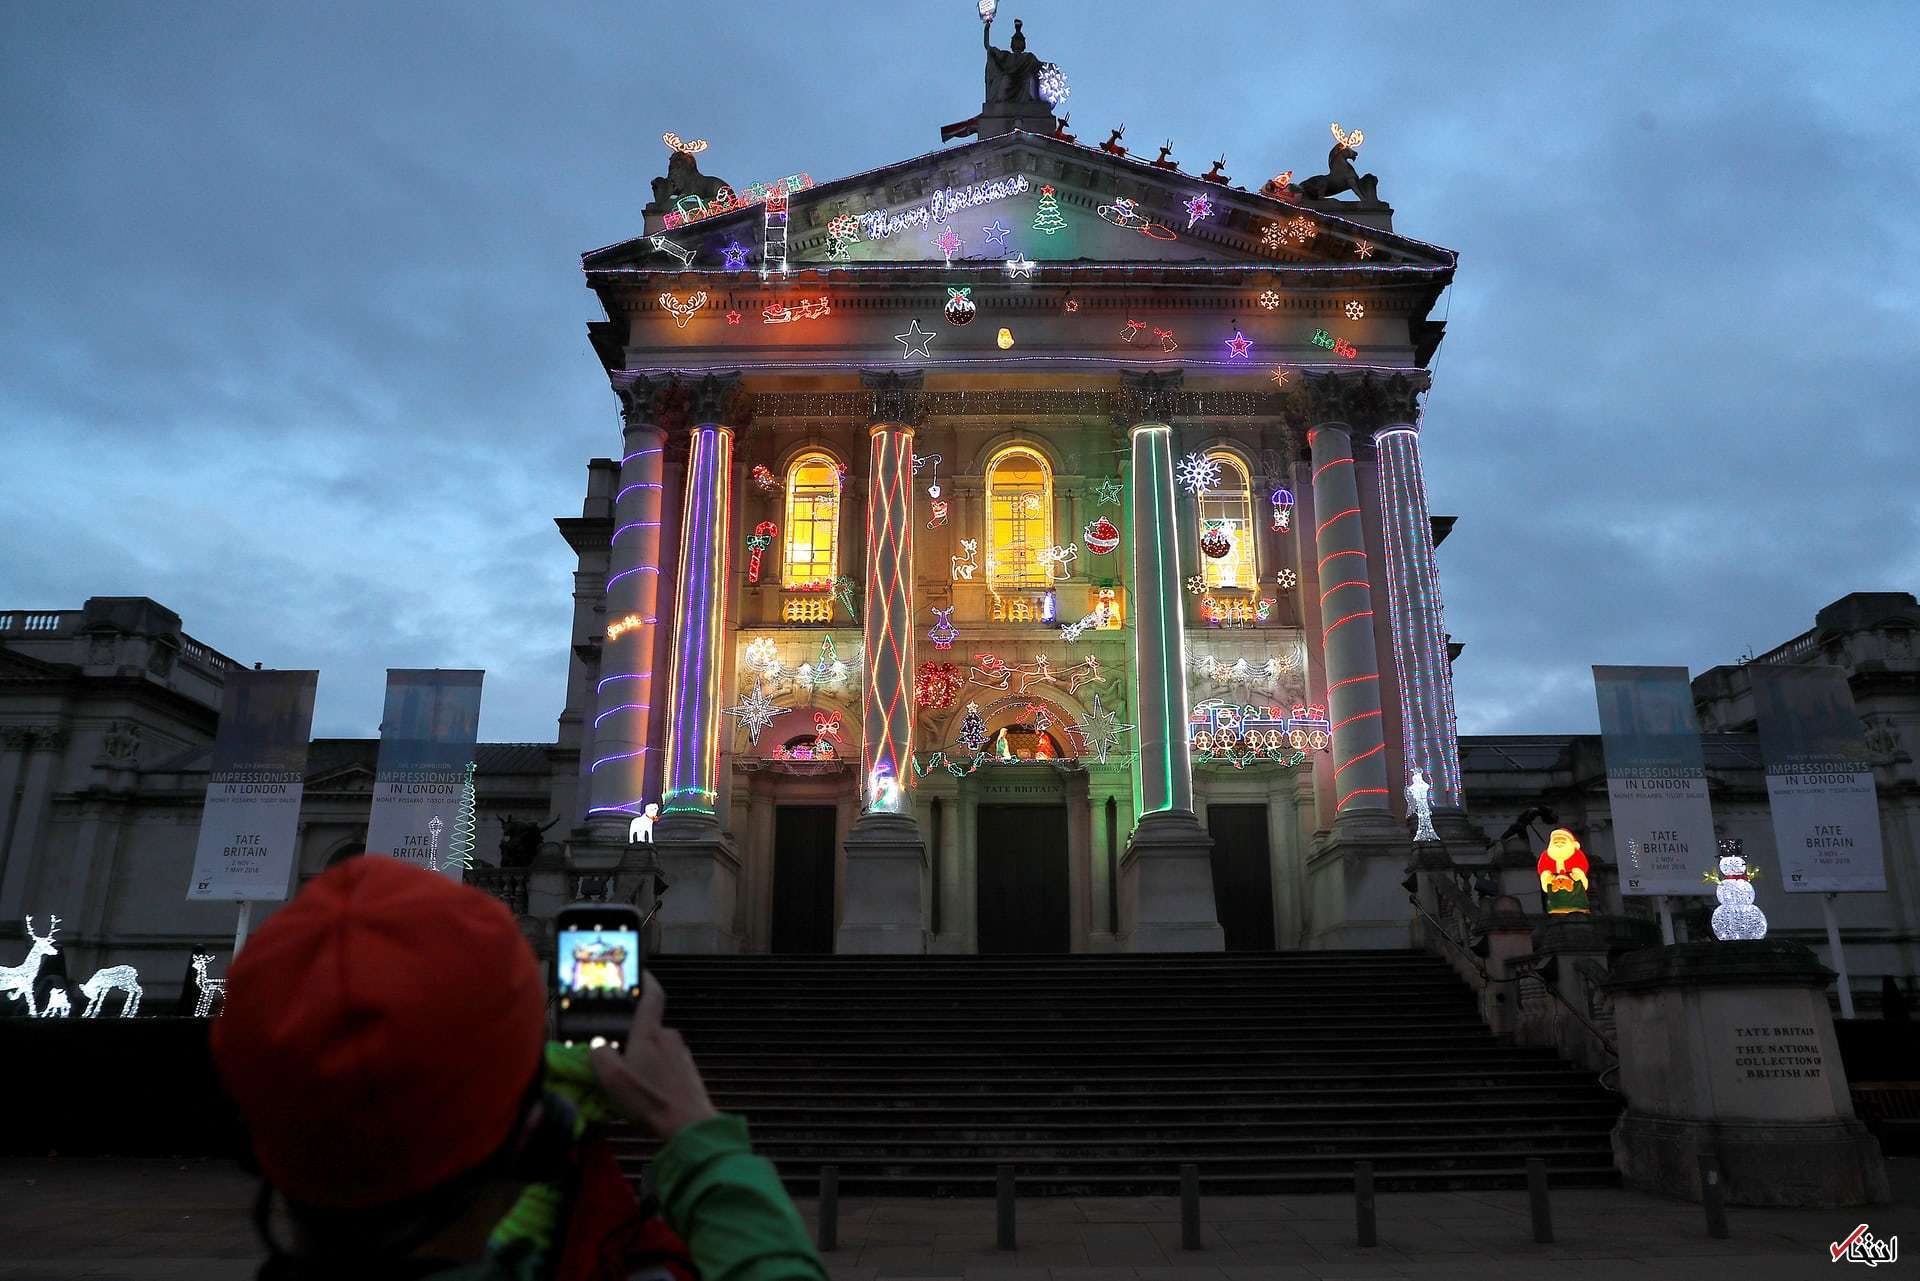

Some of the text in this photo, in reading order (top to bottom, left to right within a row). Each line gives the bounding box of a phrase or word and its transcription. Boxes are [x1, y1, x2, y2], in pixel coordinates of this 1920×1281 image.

[861, 174, 1029, 240] Merry Christmas
[1609, 767, 1703, 778] IMPRESSIONISTS
[1767, 761, 1869, 775] IMPRESSIONISTS
[211, 772, 302, 783] IMPRESSIONISTS
[1785, 774, 1855, 785] IN LONDON
[224, 784, 286, 794] IN LONDON
[390, 784, 454, 794] IN LONDON
[983, 785, 1011, 793] TATE
[1625, 779, 1690, 789] IN LONDON
[1814, 825, 1842, 836] TATE
[235, 834, 261, 845] TATE
[404, 836, 430, 846] TATE
[1650, 831, 1678, 841] TATE
[1643, 843, 1689, 853] BRITAIN
[1806, 838, 1853, 848] BRITAIN
[223, 846, 267, 857] BRITAIN
[1628, 879, 1639, 887] EY
[1791, 874, 1802, 882] EY
[1735, 1027, 1814, 1037] TATE BRITAIN
[1735, 1044, 1819, 1054] THE NATIONAL
[1735, 1056, 1812, 1066] COLLECTION
[1746, 1069, 1821, 1078] BRITISH ART
